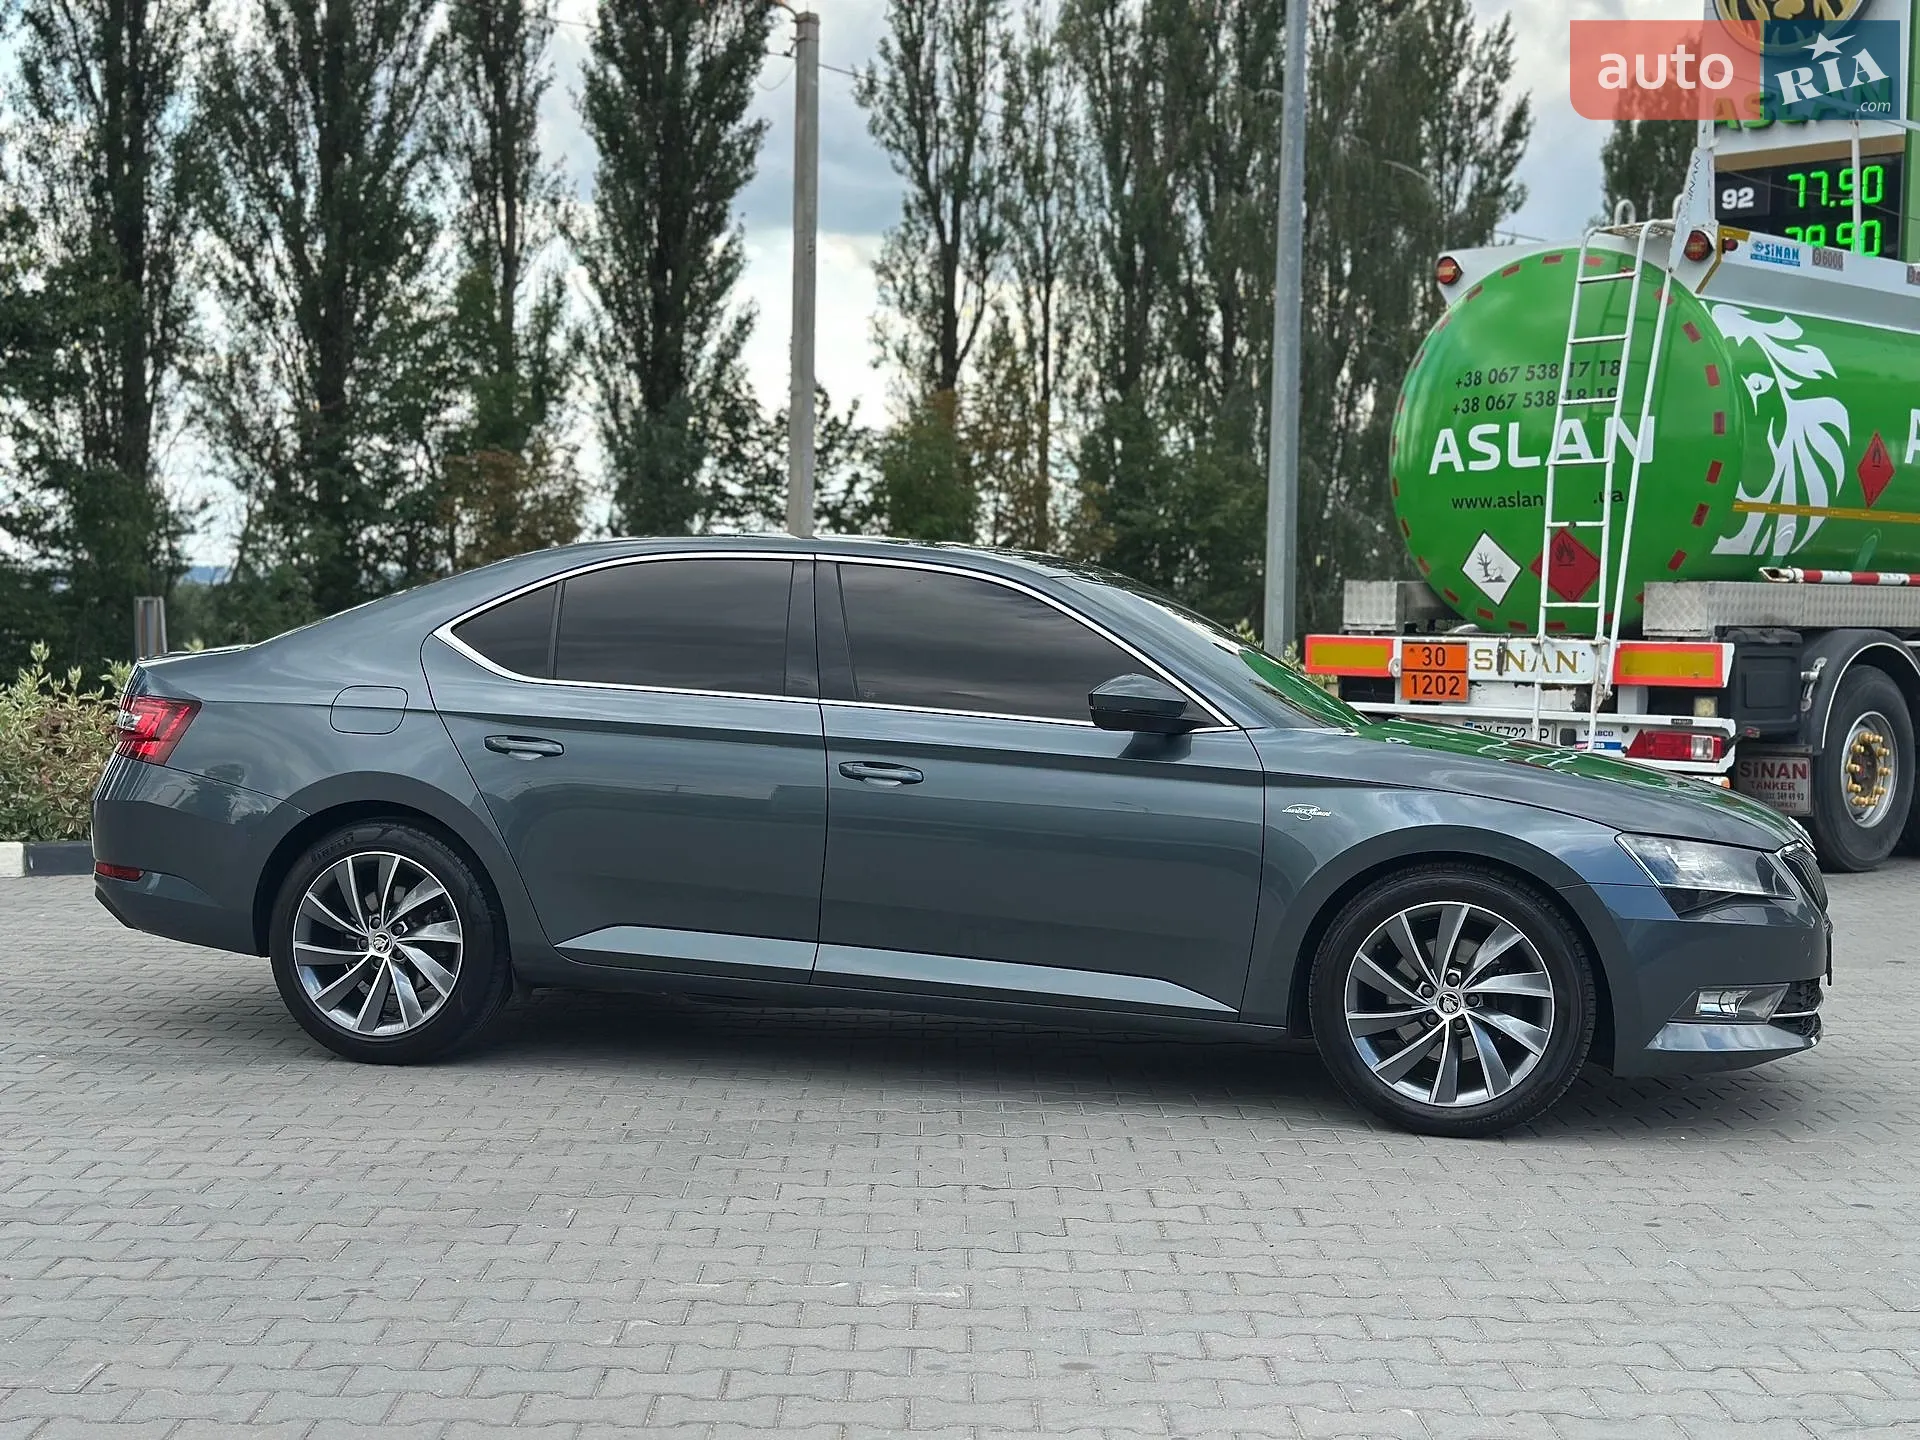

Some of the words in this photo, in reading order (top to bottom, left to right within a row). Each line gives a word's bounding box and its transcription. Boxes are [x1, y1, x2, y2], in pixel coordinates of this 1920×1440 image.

[1722, 187, 1755, 210] 92
[1788, 165, 1884, 208] 77.90
[1455, 371, 1482, 388] +38
[1488, 366, 1520, 384] 067
[1525, 363, 1559, 381] 538
[1569, 361, 1590, 378] 17
[1599, 359, 1621, 377] 18
[1453, 397, 1479, 415] +38
[1485, 393, 1518, 411] 067
[1522, 390, 1556, 408] 538
[1429, 416, 1655, 475] ASLAN
[1451, 490, 1544, 510] www.aslan
[1422, 647, 1446, 667] 30
[1474, 648, 1578, 673] SNAN
[1411, 675, 1460, 696] 1202
[1584, 729, 1614, 737] WBCO
[1750, 781, 1796, 791] TANKER
